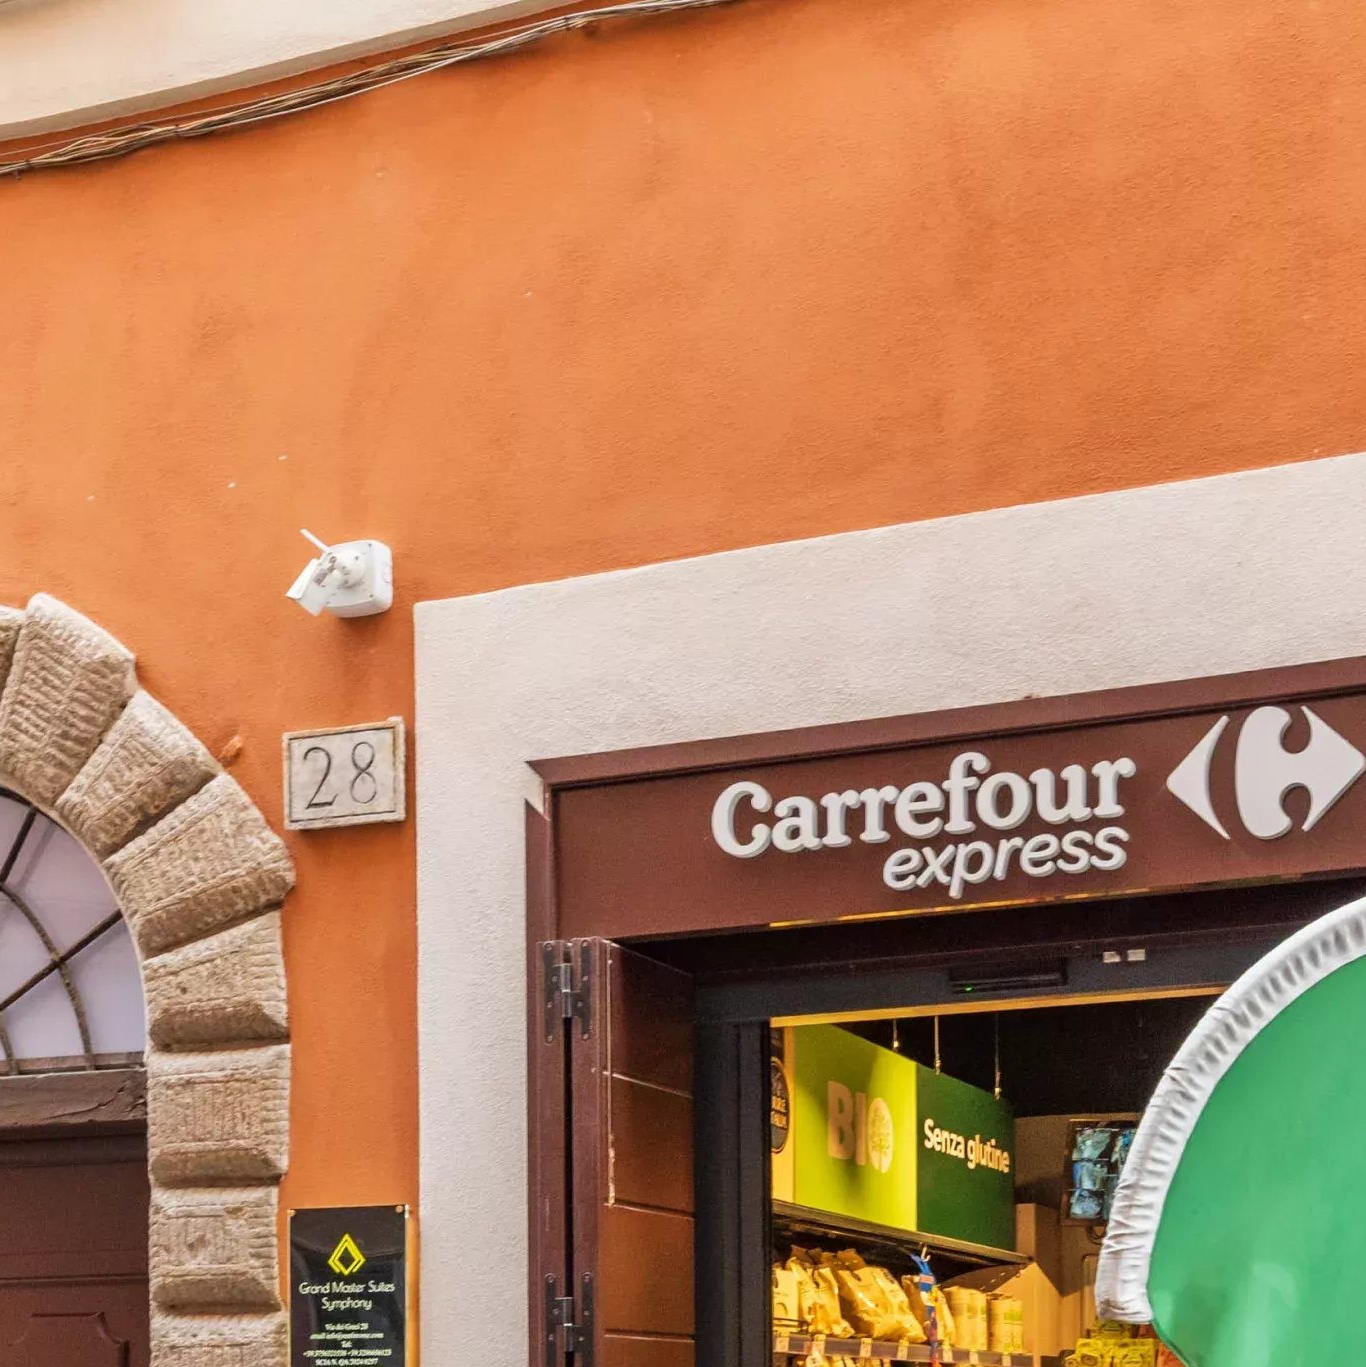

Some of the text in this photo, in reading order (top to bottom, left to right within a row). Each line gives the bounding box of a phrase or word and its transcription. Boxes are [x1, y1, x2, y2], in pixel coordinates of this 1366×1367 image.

[302, 741, 377, 810] 28
[711, 751, 1137, 859] Carrefour
[882, 823, 1131, 899] express
[923, 1117, 1010, 1174] Senza glutine
[298, 1281, 330, 1294] Grand
[321, 1296, 372, 1311] Symphony
